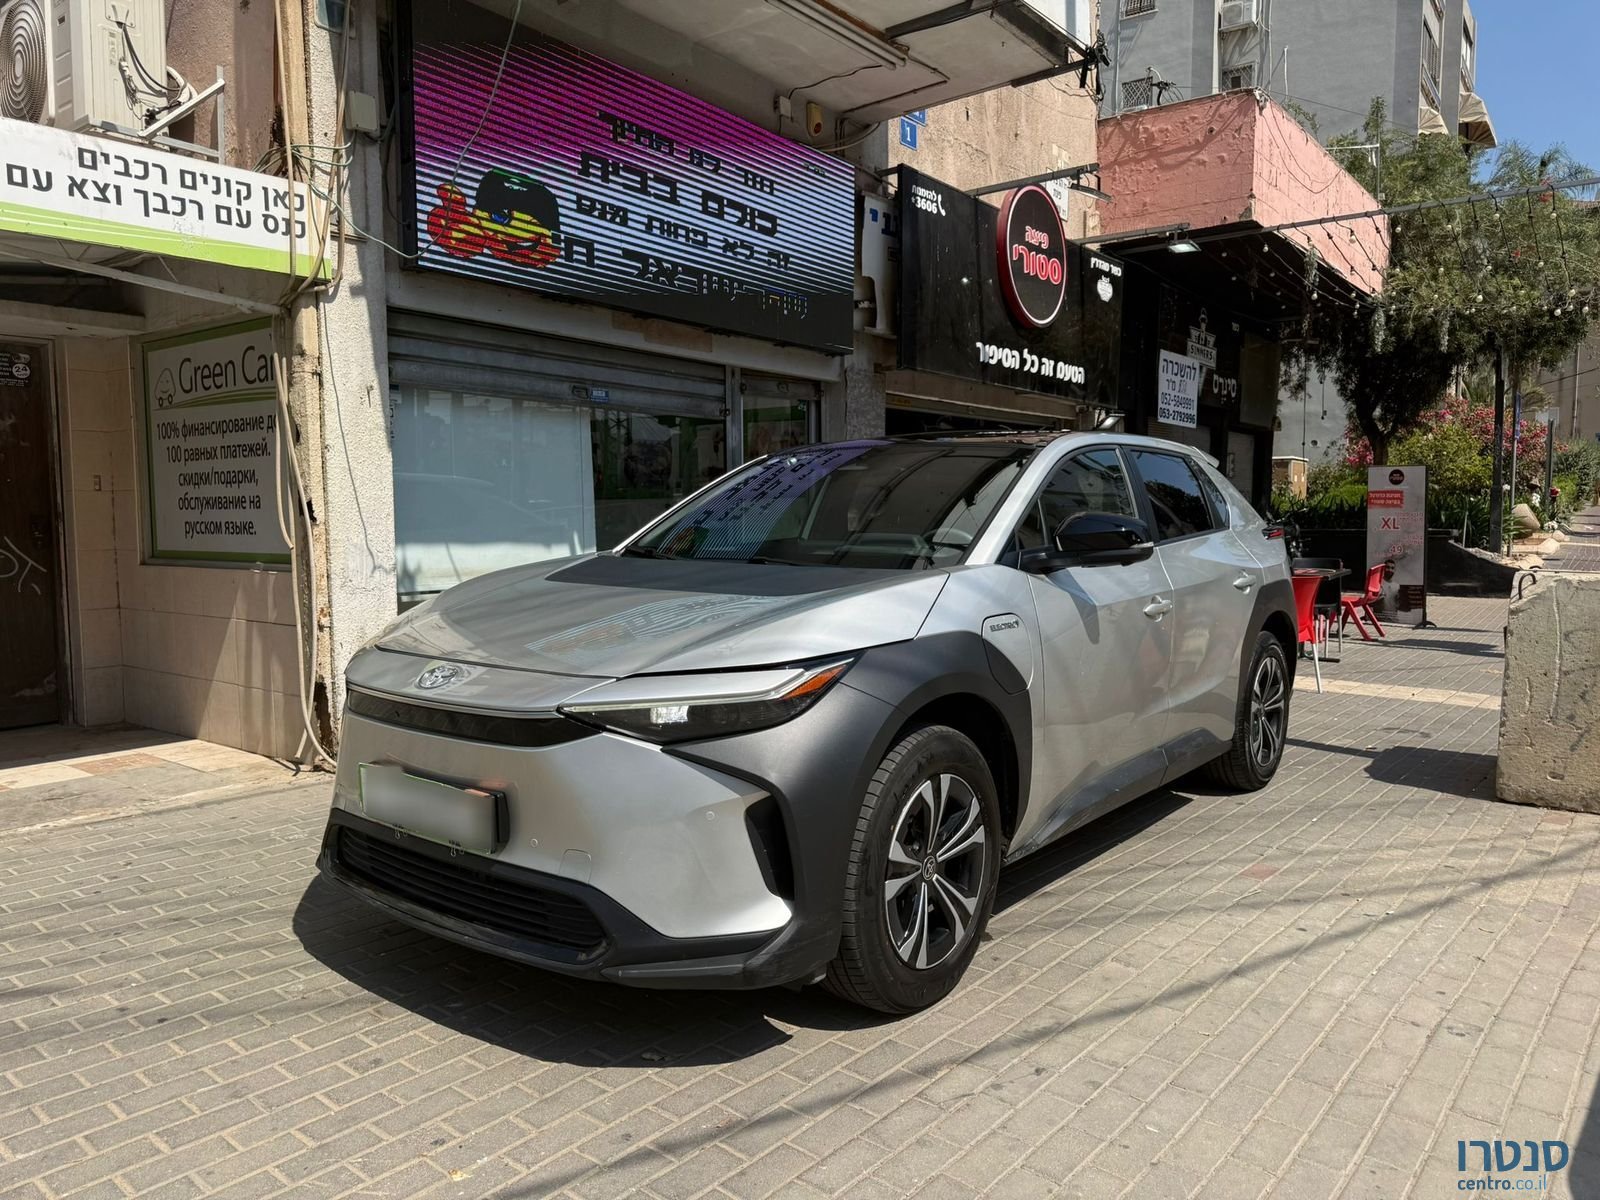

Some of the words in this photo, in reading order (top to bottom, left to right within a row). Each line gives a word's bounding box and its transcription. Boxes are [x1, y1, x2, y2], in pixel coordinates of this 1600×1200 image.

[904, 124, 911, 141] 1
[6, 163, 53, 192] עם
[78, 147, 167, 184] רכבים
[578, 149, 680, 206] בבית
[67, 175, 122, 206] וצא
[180, 168, 251, 206] קונים
[262, 186, 305, 212] כאן
[134, 188, 204, 221] רכבך
[215, 204, 251, 229] עם
[702, 190, 778, 237] כולם
[262, 214, 306, 239] כנס
[645, 213, 708, 249] פחות
[1025, 225, 1049, 249] פיצה
[722, 235, 754, 260] לא
[767, 249, 791, 271] זה
[1013, 244, 1062, 285] סטורי
[976, 341, 1020, 370] הסיפור
[1023, 348, 1039, 373] כל
[1041, 357, 1054, 377] זה
[179, 357, 236, 394] Green
[1056, 361, 1085, 385] הטעם
[1162, 358, 1197, 382] להשכרה
[157, 417, 180, 440] 100%
[181, 415, 265, 442] финансирование
[166, 445, 182, 464] 100
[184, 446, 218, 466] равных
[220, 438, 271, 461] платежей.
[178, 466, 259, 489] скидки/подарки,
[178, 492, 247, 515] обслуживание
[249, 494, 261, 510] на
[184, 520, 223, 539] русском
[224, 518, 257, 536] языке.
[1381, 517, 1400, 530] XL
